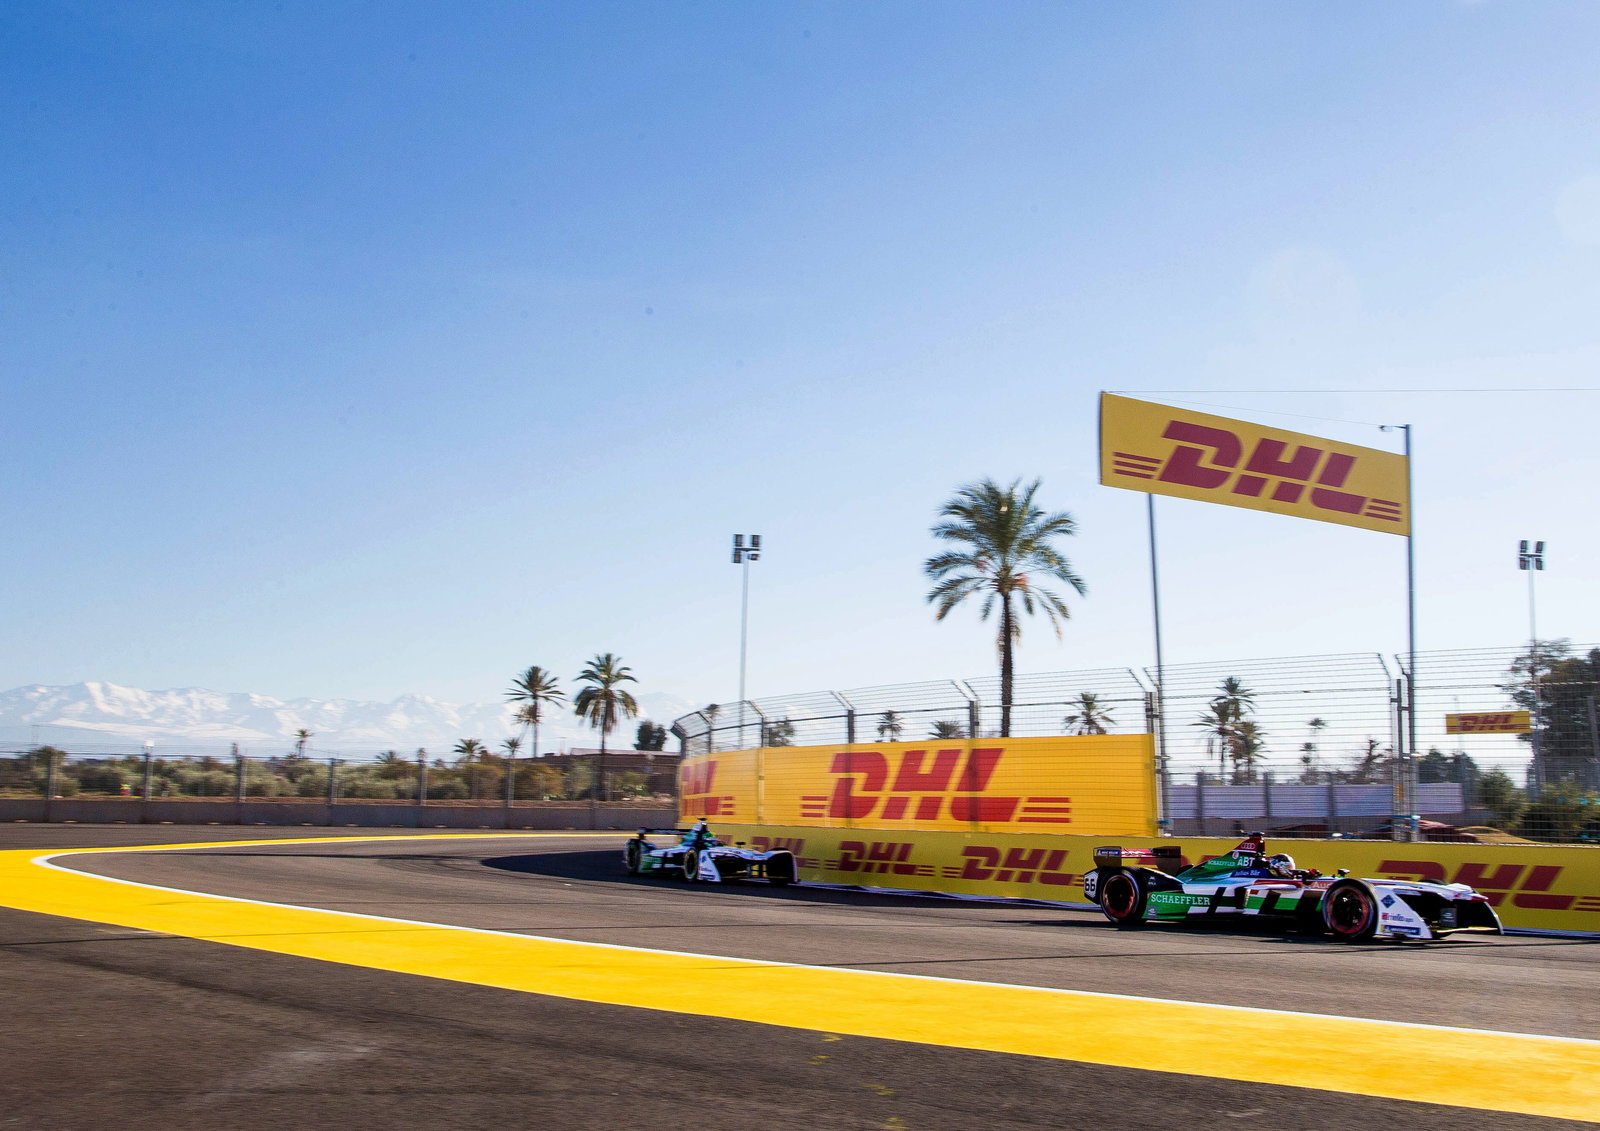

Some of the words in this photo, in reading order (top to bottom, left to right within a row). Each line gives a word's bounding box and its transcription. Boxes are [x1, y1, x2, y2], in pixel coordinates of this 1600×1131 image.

[1157, 419, 1369, 515] DHL
[1457, 714, 1515, 731] DHL
[827, 747, 1020, 822] DHL
[838, 841, 918, 876] DHL
[961, 846, 1075, 886] DHL
[1237, 857, 1255, 867] ABT
[1085, 878, 1096, 892] 66
[1150, 894, 1211, 906] SCHAEFFLER
